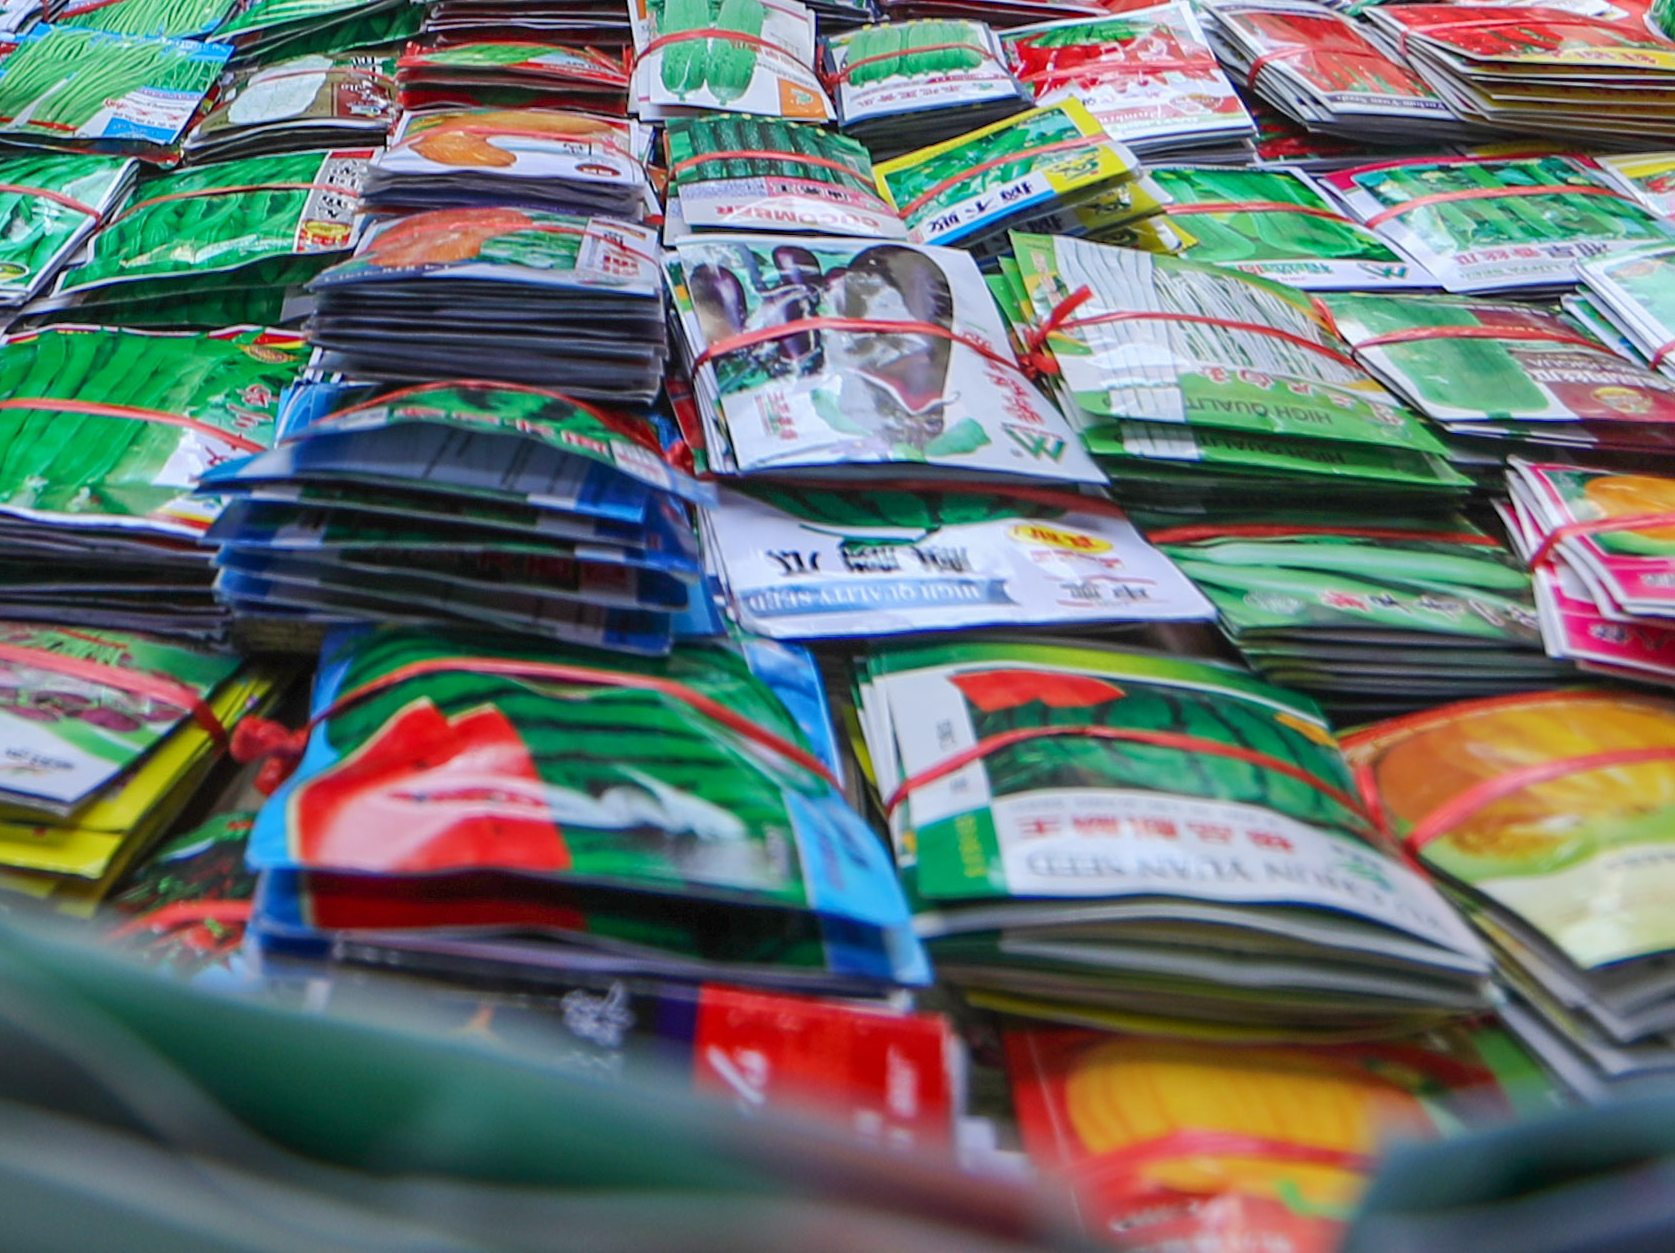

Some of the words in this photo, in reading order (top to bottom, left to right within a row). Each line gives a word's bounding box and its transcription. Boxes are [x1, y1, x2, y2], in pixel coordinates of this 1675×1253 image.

[714, 203, 880, 229] CUCUMBER
[1186, 396, 1270, 418] QUALIT
[1274, 405, 1333, 425] HIGH
[819, 583, 916, 605] QUALITY
[922, 582, 980, 600] HIGH
